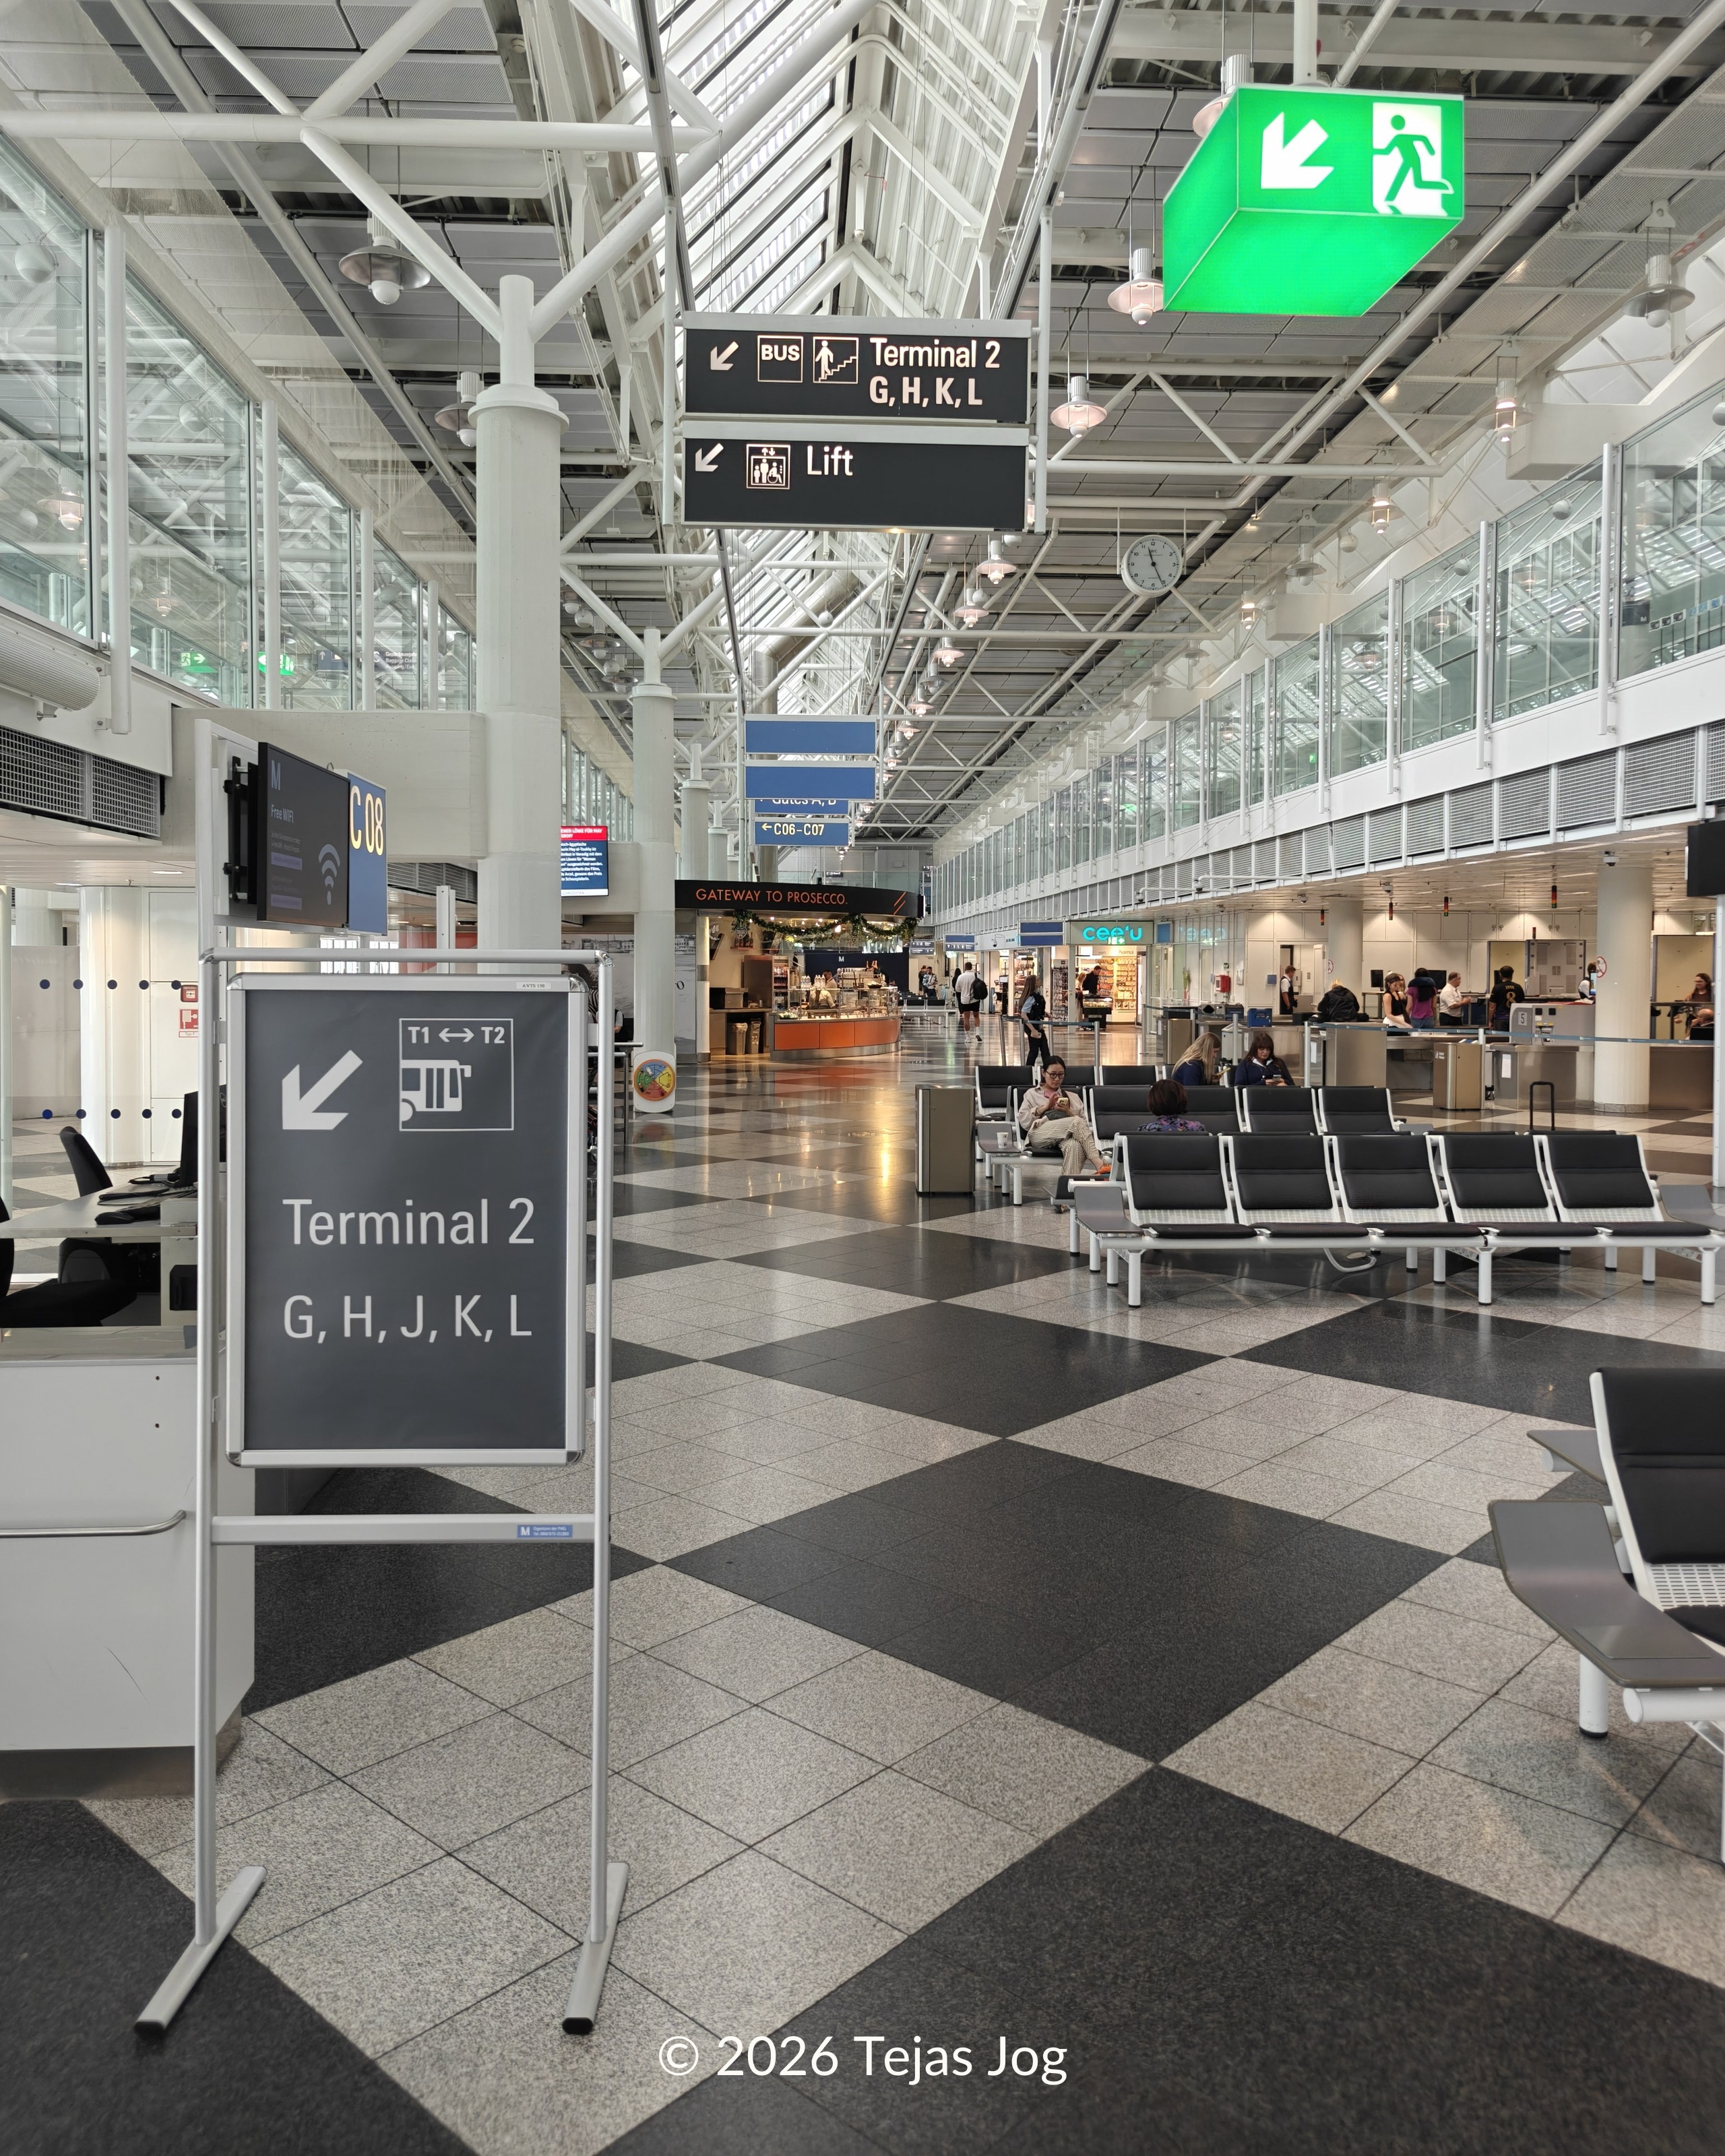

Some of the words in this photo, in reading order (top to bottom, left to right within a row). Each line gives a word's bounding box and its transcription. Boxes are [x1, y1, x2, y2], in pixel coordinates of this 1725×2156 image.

[761, 343, 801, 362] BUS
[870, 338, 977, 368] Terminal
[985, 341, 1001, 369] 2
[870, 376, 896, 407] G,
[902, 377, 929, 408] H,
[936, 378, 962, 408] K,
[968, 379, 983, 406] L
[807, 445, 854, 476] Lift
[271, 760, 281, 790] M
[271, 804, 283, 820] Free
[696, 889, 761, 901] GATEWAY
[766, 891, 783, 903] TO
[1520, 1013, 1525, 1024] 5
[408, 1027, 429, 1044] T1
[481, 1027, 505, 1044] T2
[282, 1199, 488, 1246] Terminal
[509, 1198, 534, 1244] 2
[284, 1295, 327, 1344] G,
[344, 1296, 387, 1343] H,
[401, 1296, 437, 1343] J,
[456, 1295, 493, 1342] K,
[511, 1295, 532, 1336] L
[521, 1526, 530, 1535] M
